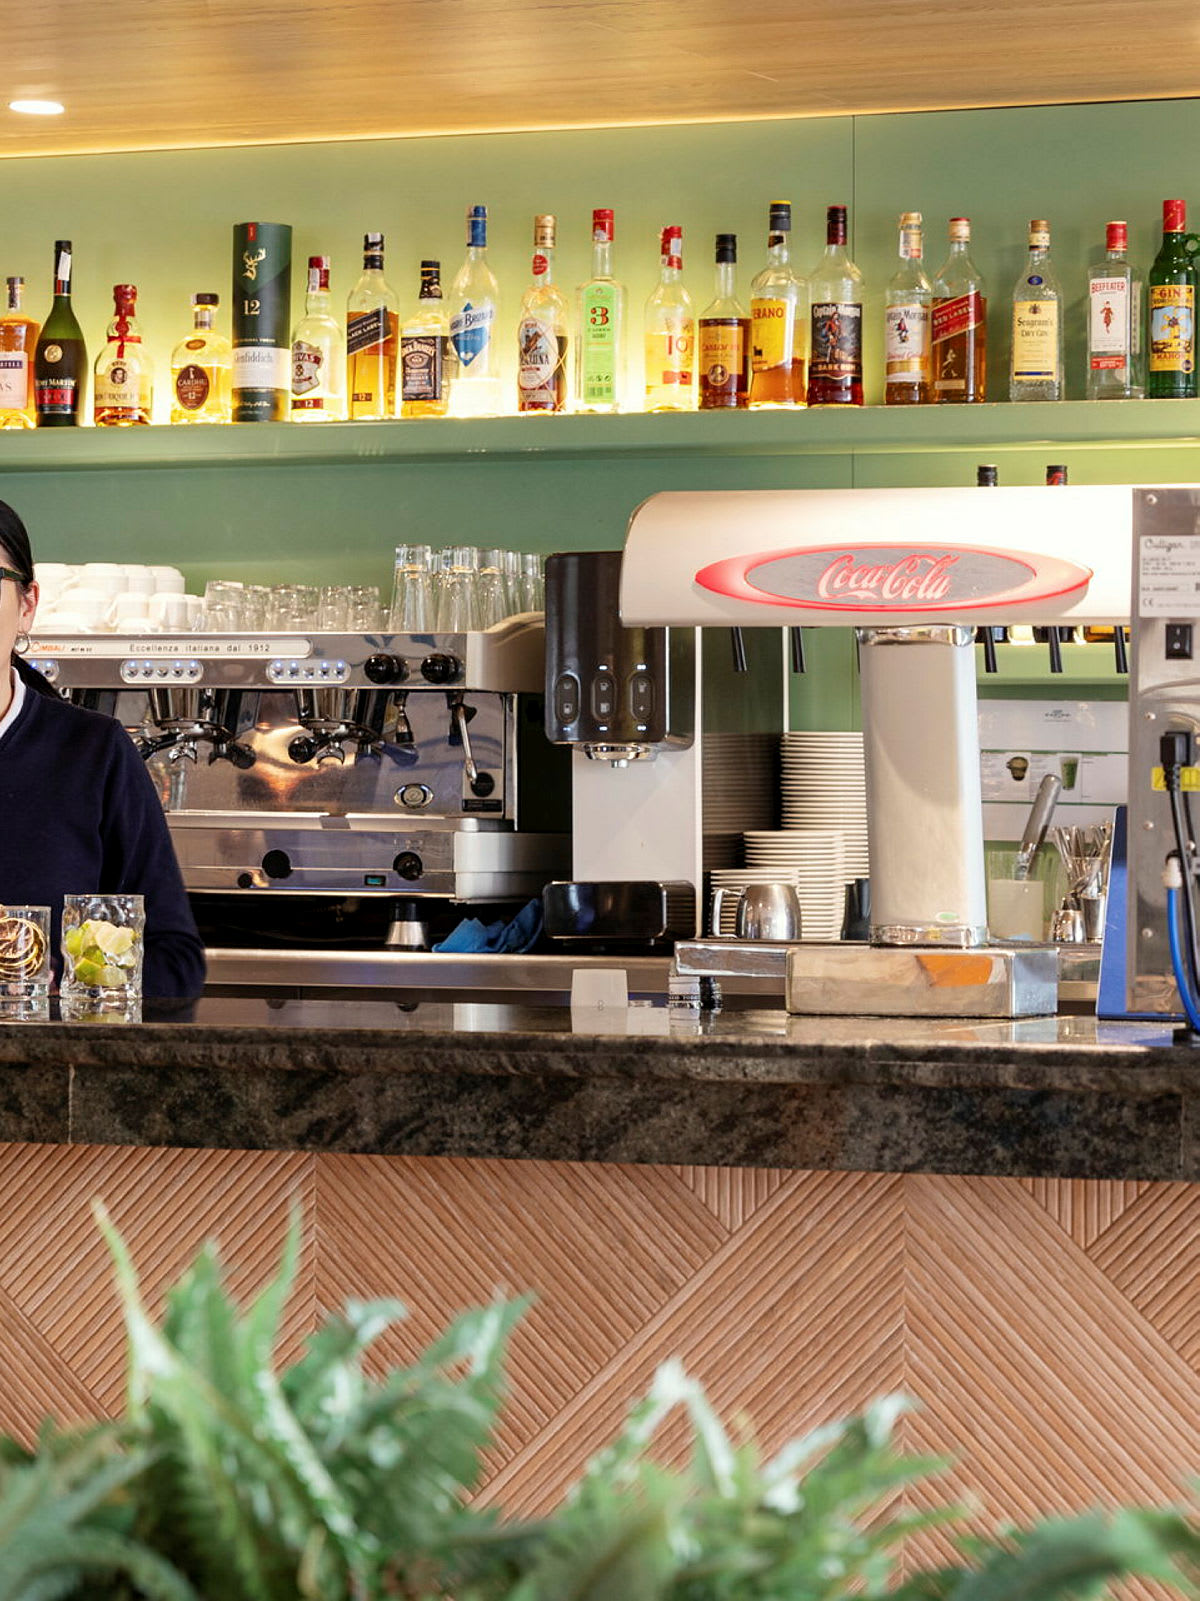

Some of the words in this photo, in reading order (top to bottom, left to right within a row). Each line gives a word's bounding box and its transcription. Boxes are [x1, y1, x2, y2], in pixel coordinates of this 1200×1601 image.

[1092, 282, 1125, 293] BEEFEATER
[1160, 288, 1181, 298] GIN
[244, 300, 260, 315] 12
[591, 306, 609, 326] 3
[305, 400, 313, 408] 12
[129, 643, 179, 652] Eccellenza
[185, 643, 220, 652] italiana
[227, 643, 241, 652] dal
[249, 643, 270, 652] 1912
